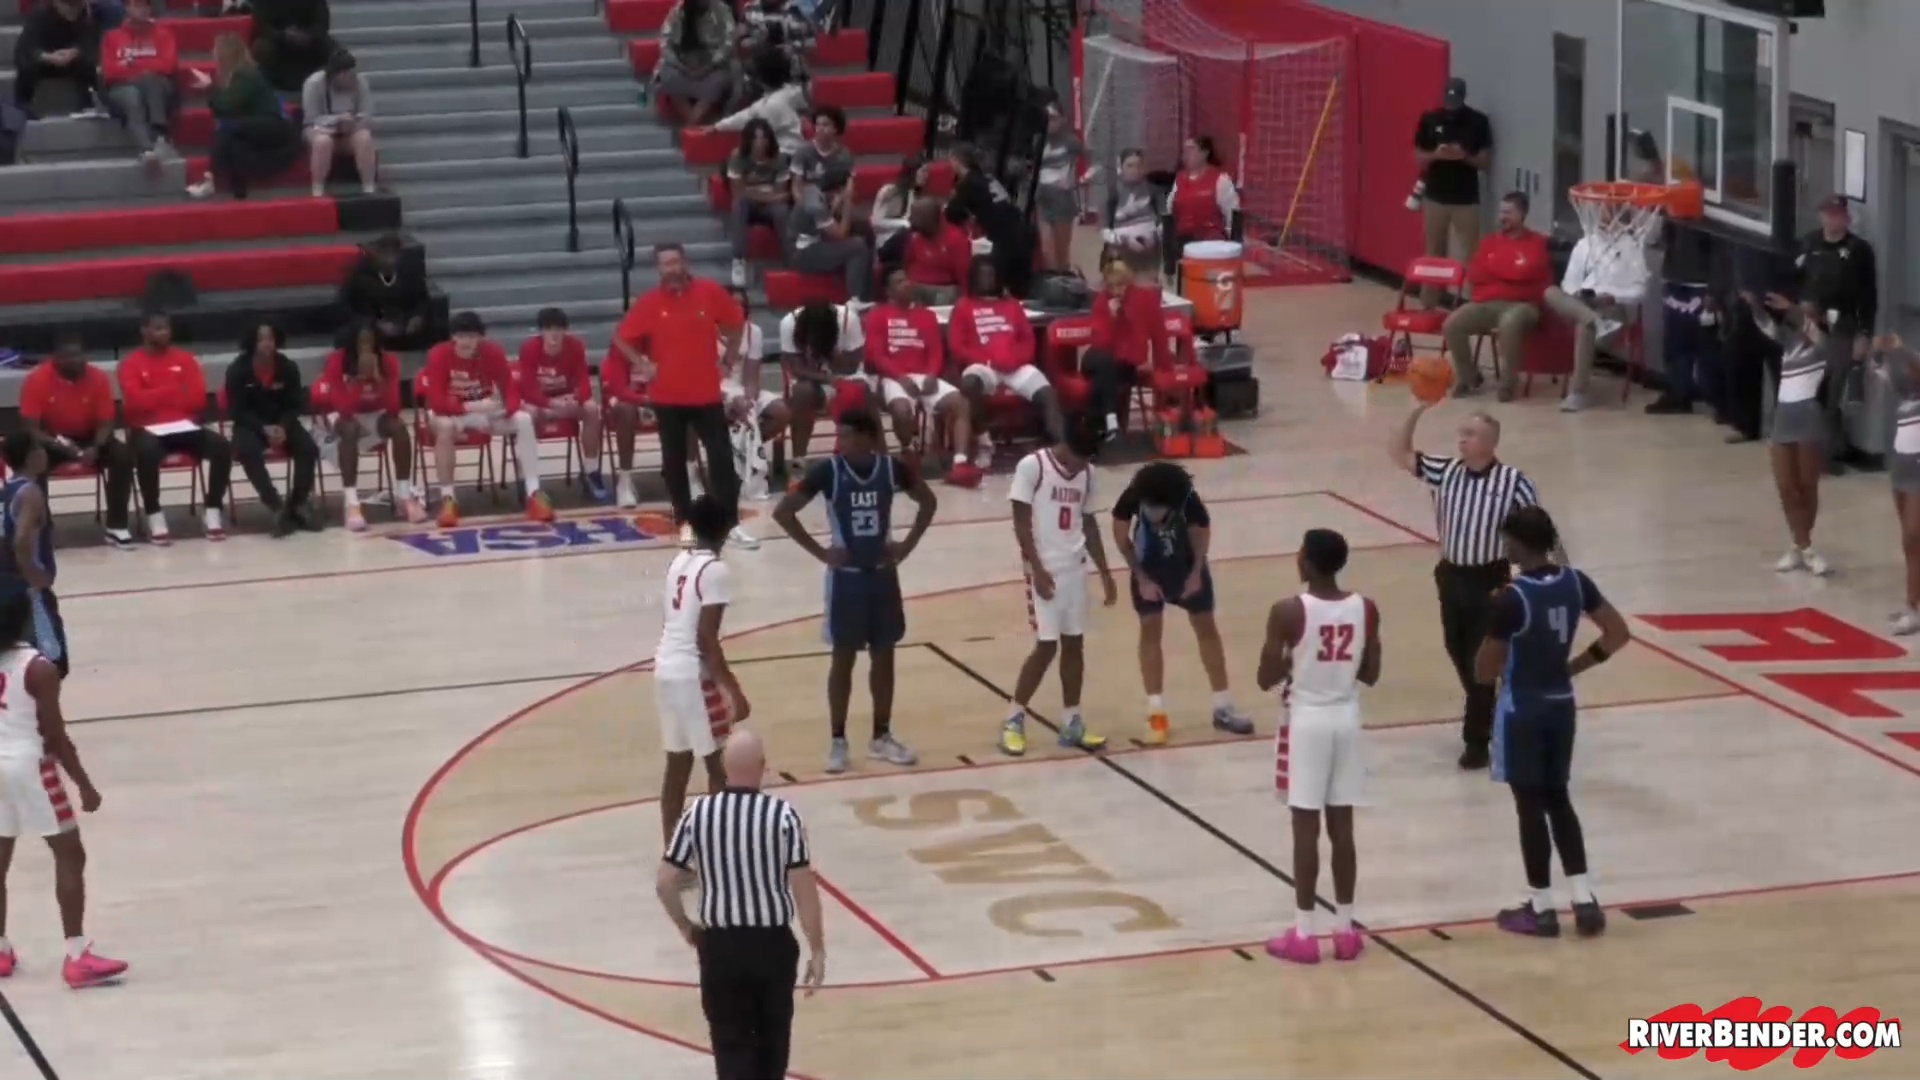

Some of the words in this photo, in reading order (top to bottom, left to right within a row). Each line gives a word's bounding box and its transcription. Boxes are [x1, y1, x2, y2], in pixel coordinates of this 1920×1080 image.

[851, 491, 877, 507] EAST
[851, 510, 879, 536] 23
[1059, 506, 1071, 530] 0
[1547, 606, 1568, 643] 4
[1317, 624, 1354, 662] 32
[842, 789, 1183, 937] SWC
